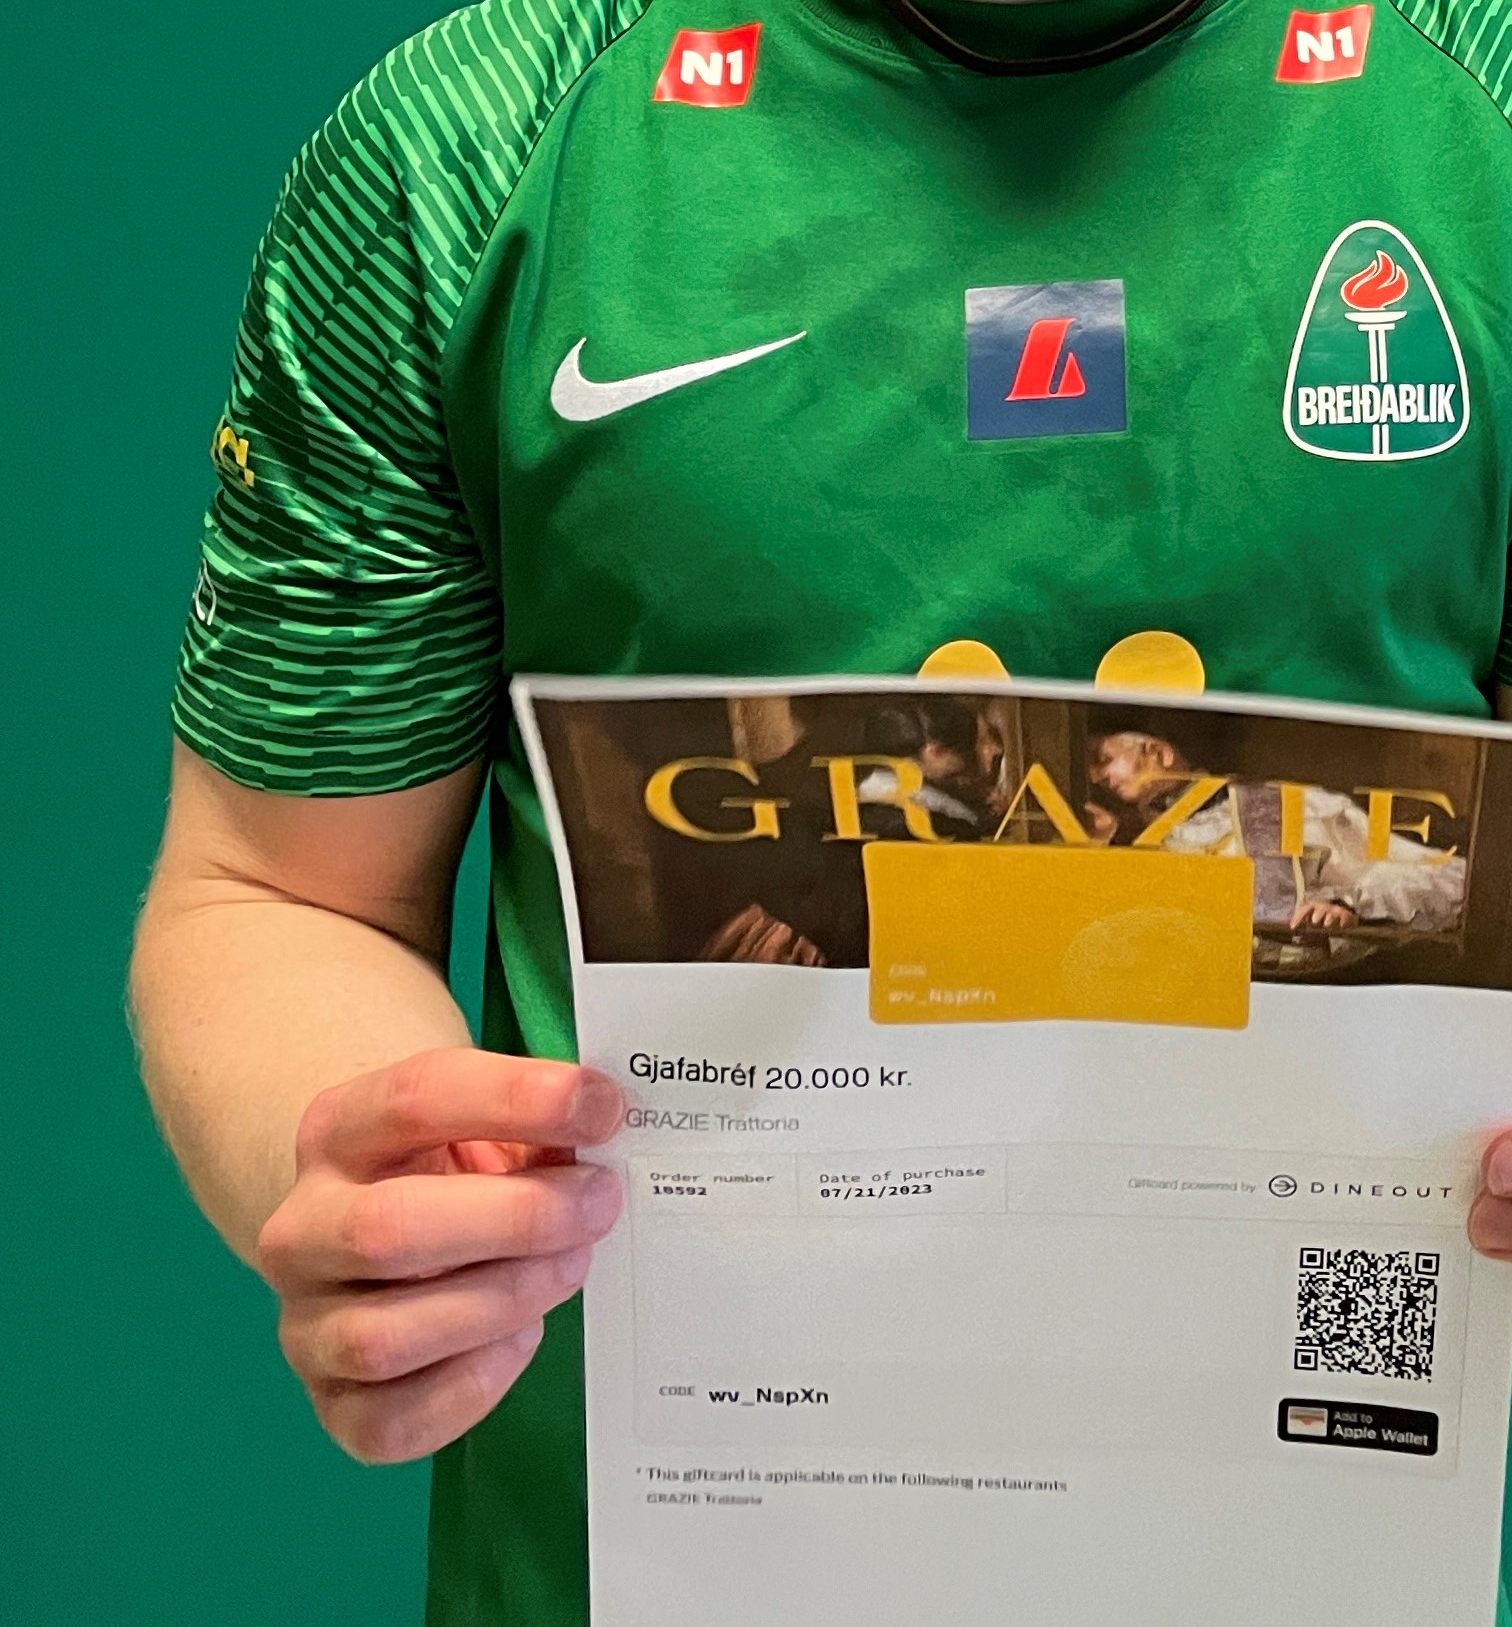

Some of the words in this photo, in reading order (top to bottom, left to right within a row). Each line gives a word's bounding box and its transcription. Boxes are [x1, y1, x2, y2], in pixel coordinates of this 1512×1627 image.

[1296, 25, 1356, 64] N1
[680, 49, 744, 86] N1
[1297, 383, 1456, 426] BREIÐABLIK
[644, 754, 1459, 866] GRAZIE
[629, 1052, 757, 1089] Gjafabréf
[765, 1066, 870, 1090] 20.000
[880, 1066, 913, 1087] kr.
[626, 1108, 709, 1132] GRAZIE
[717, 1113, 800, 1132] Trattoria
[649, 1172, 700, 1183] Order
[713, 1173, 775, 1184] number
[820, 1173, 861, 1184] Date
[871, 1171, 891, 1182] of
[903, 1166, 986, 1182] purchase
[820, 1183, 933, 1200] 07/21/2023
[1310, 1181, 1453, 1200] DINEOUT
[708, 1387, 829, 1407] wv_NspXn
[1332, 1423, 1377, 1440] Apple
[1381, 1427, 1429, 1447] Wallet
[647, 1467, 680, 1481] This
[683, 1468, 745, 1483] giftcard
[764, 1470, 845, 1485] applicable
[848, 1473, 869, 1484] on
[872, 1472, 897, 1484] the
[902, 1472, 974, 1490] following
[977, 1476, 1068, 1492] restaurants
